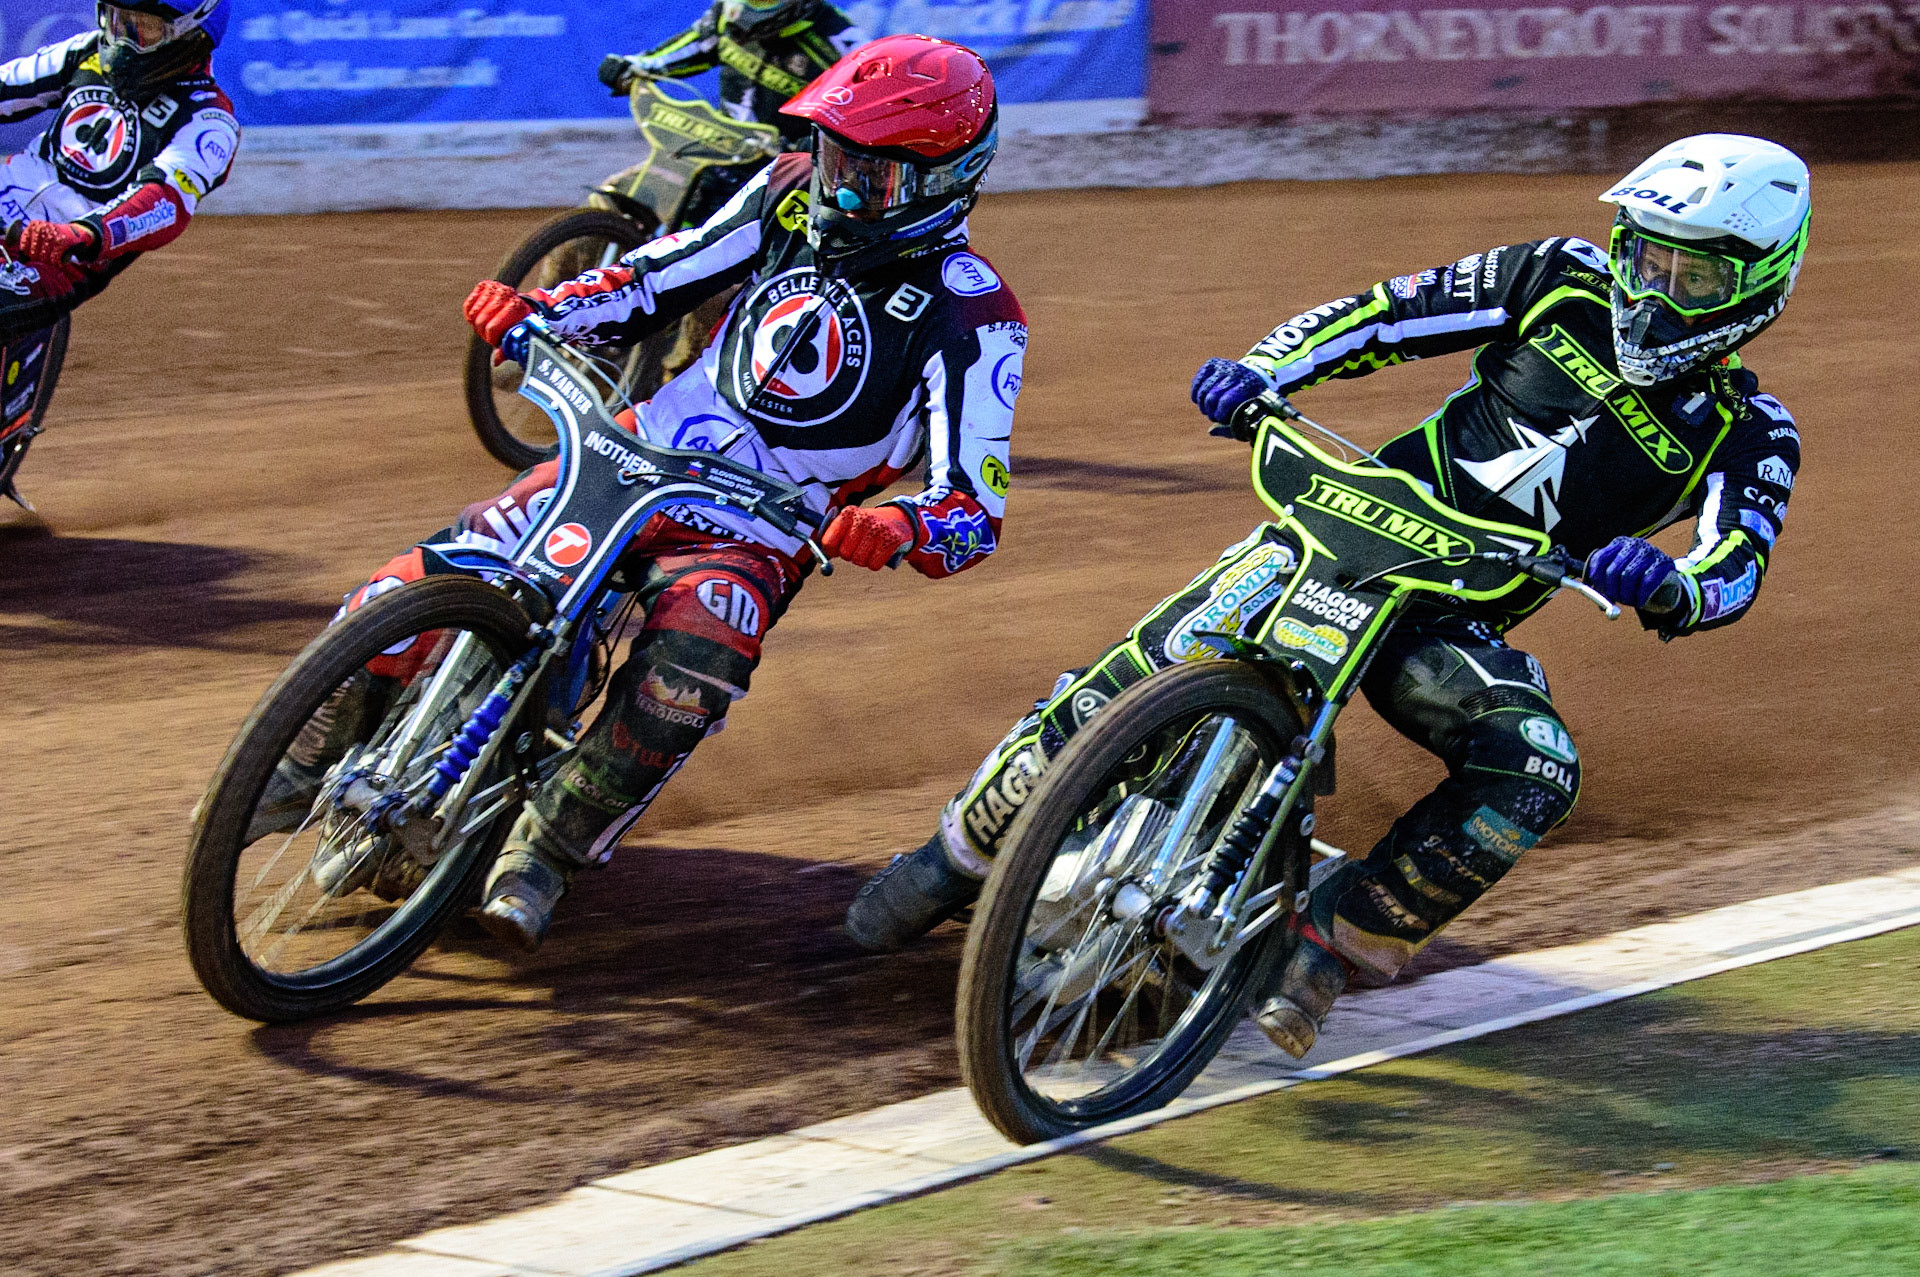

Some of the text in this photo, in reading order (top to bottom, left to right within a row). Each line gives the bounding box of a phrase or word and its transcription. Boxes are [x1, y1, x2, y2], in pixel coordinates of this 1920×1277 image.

[1215, 6, 1700, 65] THORNEYCROFT
[1611, 187, 1690, 215] BOLL
[768, 276, 820, 303] BELLE
[957, 261, 987, 287] ATPI
[842, 317, 863, 368] ACES
[1551, 339, 1614, 393] TRU
[1613, 394, 1681, 463] MIX
[584, 430, 665, 485] INOTHERM
[1315, 483, 1463, 556] TRU MIX
[696, 578, 760, 637] GM
[1180, 557, 1283, 649] AGROMIX
[1291, 593, 1363, 631] SHOCKS
[1299, 578, 1375, 620] HAGON
[1524, 755, 1573, 793] BOLL
